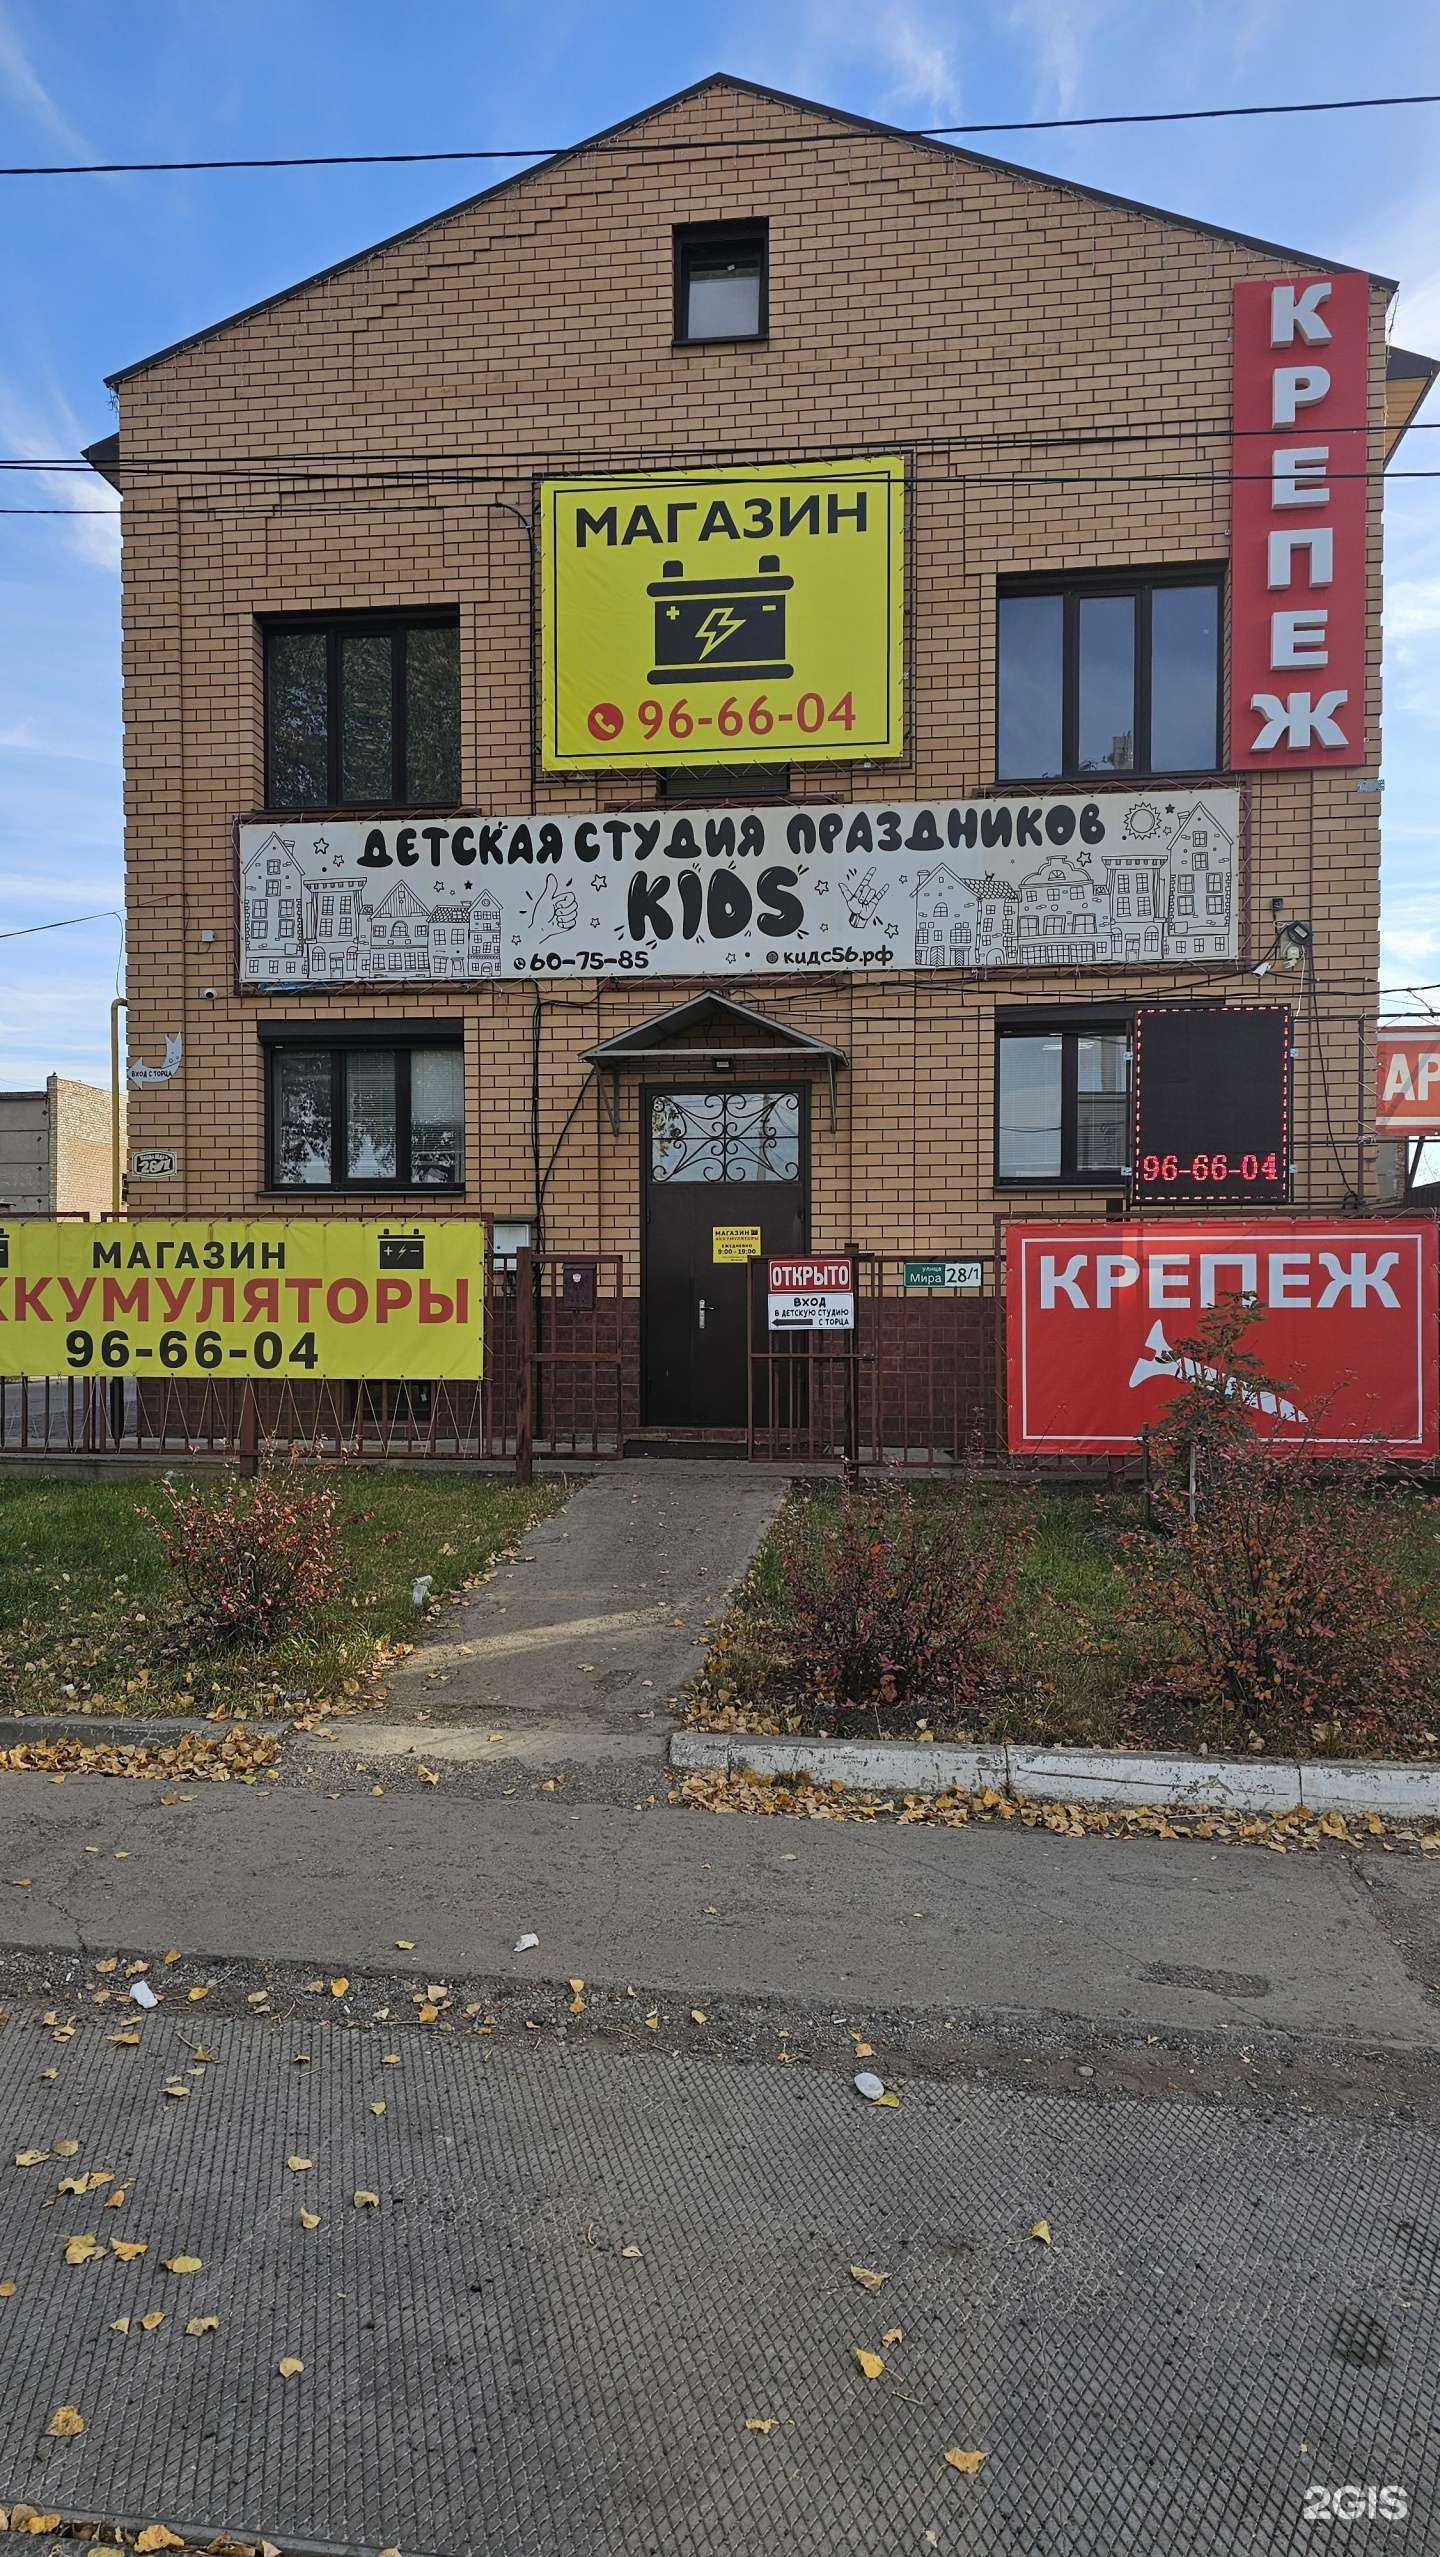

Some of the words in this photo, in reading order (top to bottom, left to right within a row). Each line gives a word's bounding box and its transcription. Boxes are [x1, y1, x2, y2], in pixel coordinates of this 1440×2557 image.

[576, 491, 868, 548] МАГАЗИН
[1250, 282, 1348, 751] КРЕПЕЖ
[637, 692, 856, 739] 96-66-04
[357, 823, 563, 868] ДЕТСКАЯ
[574, 815, 765, 861] СТУДИЯ
[786, 804, 1106, 855] ПРАЗДНИКОВ
[627, 866, 805, 941] KIDS
[529, 951, 649, 971] 60-75-85
[783, 946, 894, 967] кидс56.рф
[1143, 1152, 1277, 1181] 96-66-04
[92, 1242, 285, 1269] МАГАЗИН
[772, 1266, 849, 1287] ОТКРЫТО
[910, 1273, 942, 1285] Мира
[946, 1268, 979, 1283] 28/1
[1039, 1252, 1401, 1309] КРЕПЕЖ
[0, 1277, 468, 1324] КУМУЛЯТОРЫ
[782, 1310, 816, 1318] ДЕТСКУЮ
[818, 1309, 849, 1317] СТУДИЮ
[793, 1297, 826, 1307] ВХОД
[826, 1318, 849, 1327] ТОРЦА
[66, 1330, 318, 1369] 96-66-04
